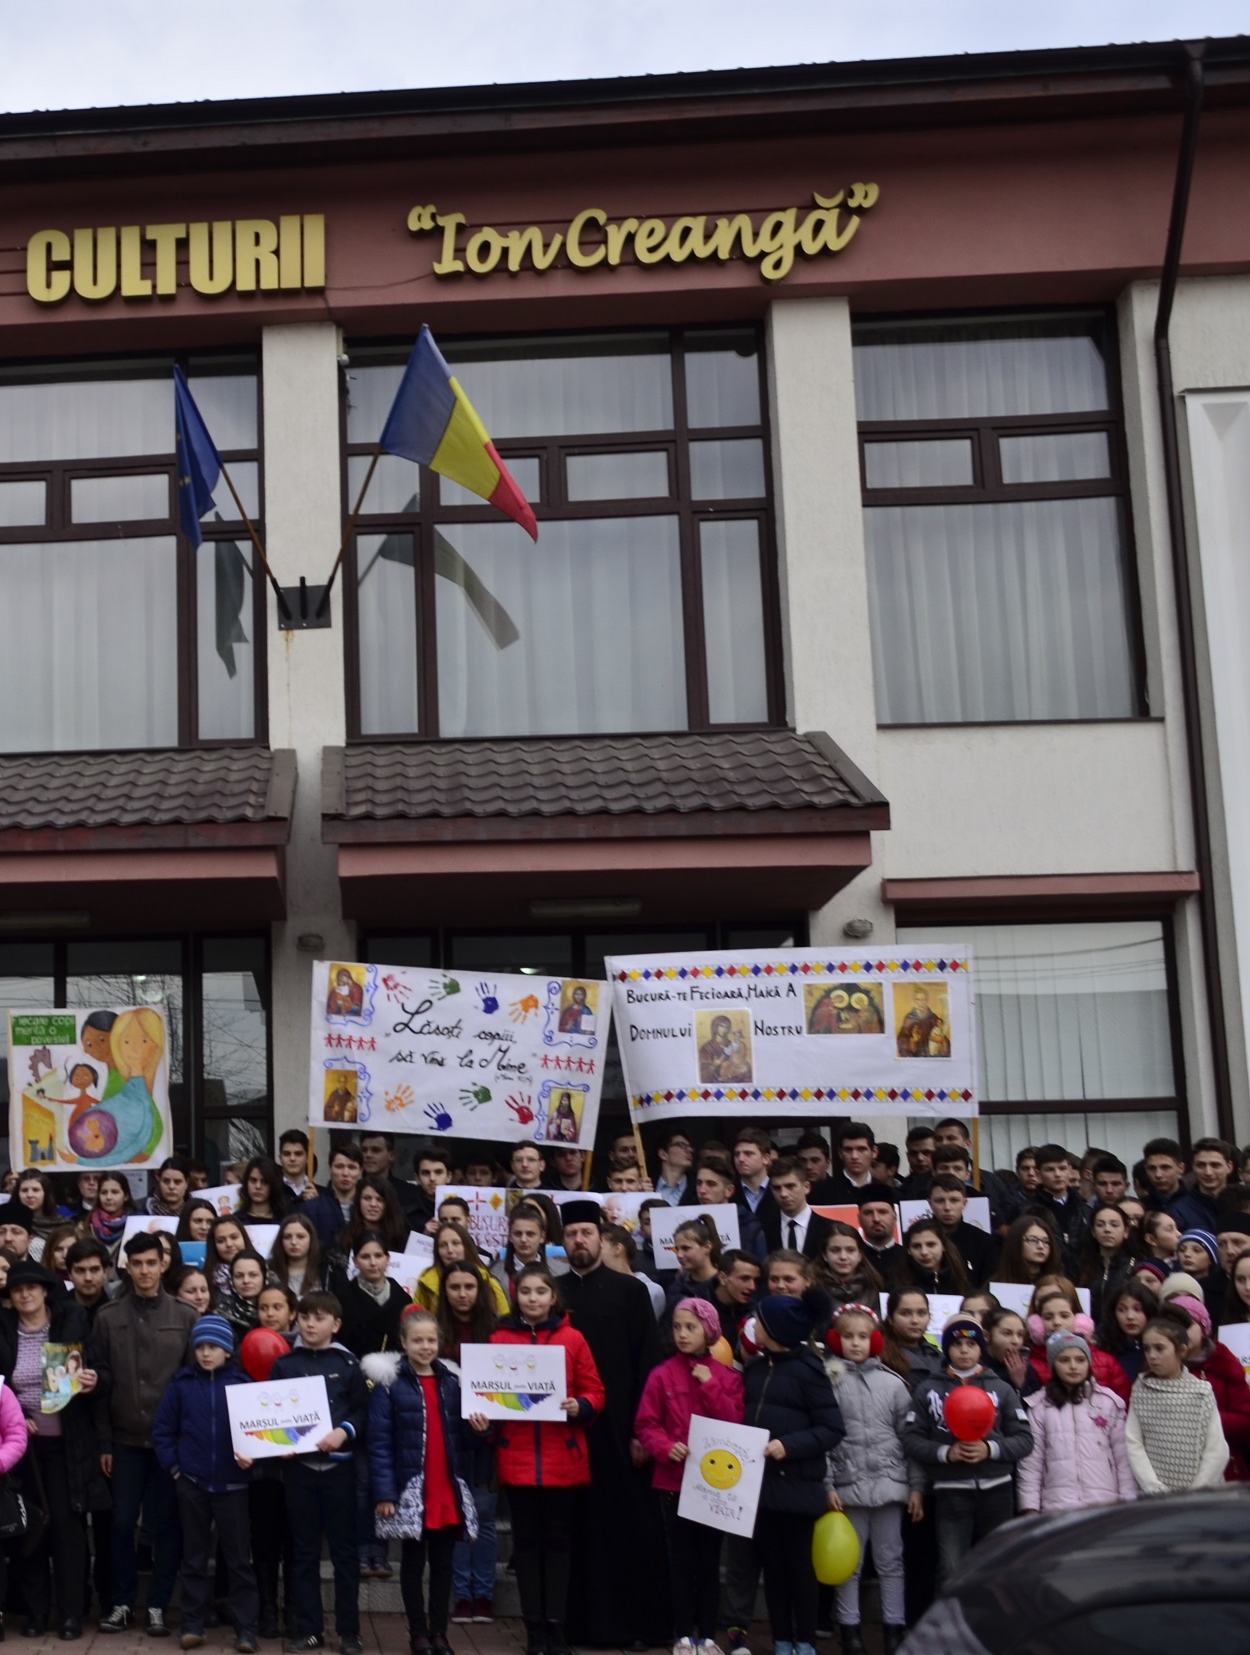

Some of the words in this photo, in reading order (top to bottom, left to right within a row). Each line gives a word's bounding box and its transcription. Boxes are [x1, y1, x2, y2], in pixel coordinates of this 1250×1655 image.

[26, 214, 325, 302] CULTURII
[786, 982, 797, 998] A
[49, 1026, 57, 1035] o
[754, 1019, 803, 1037] NOSTRU
[527, 1381, 557, 1393] VIAȚĂ
